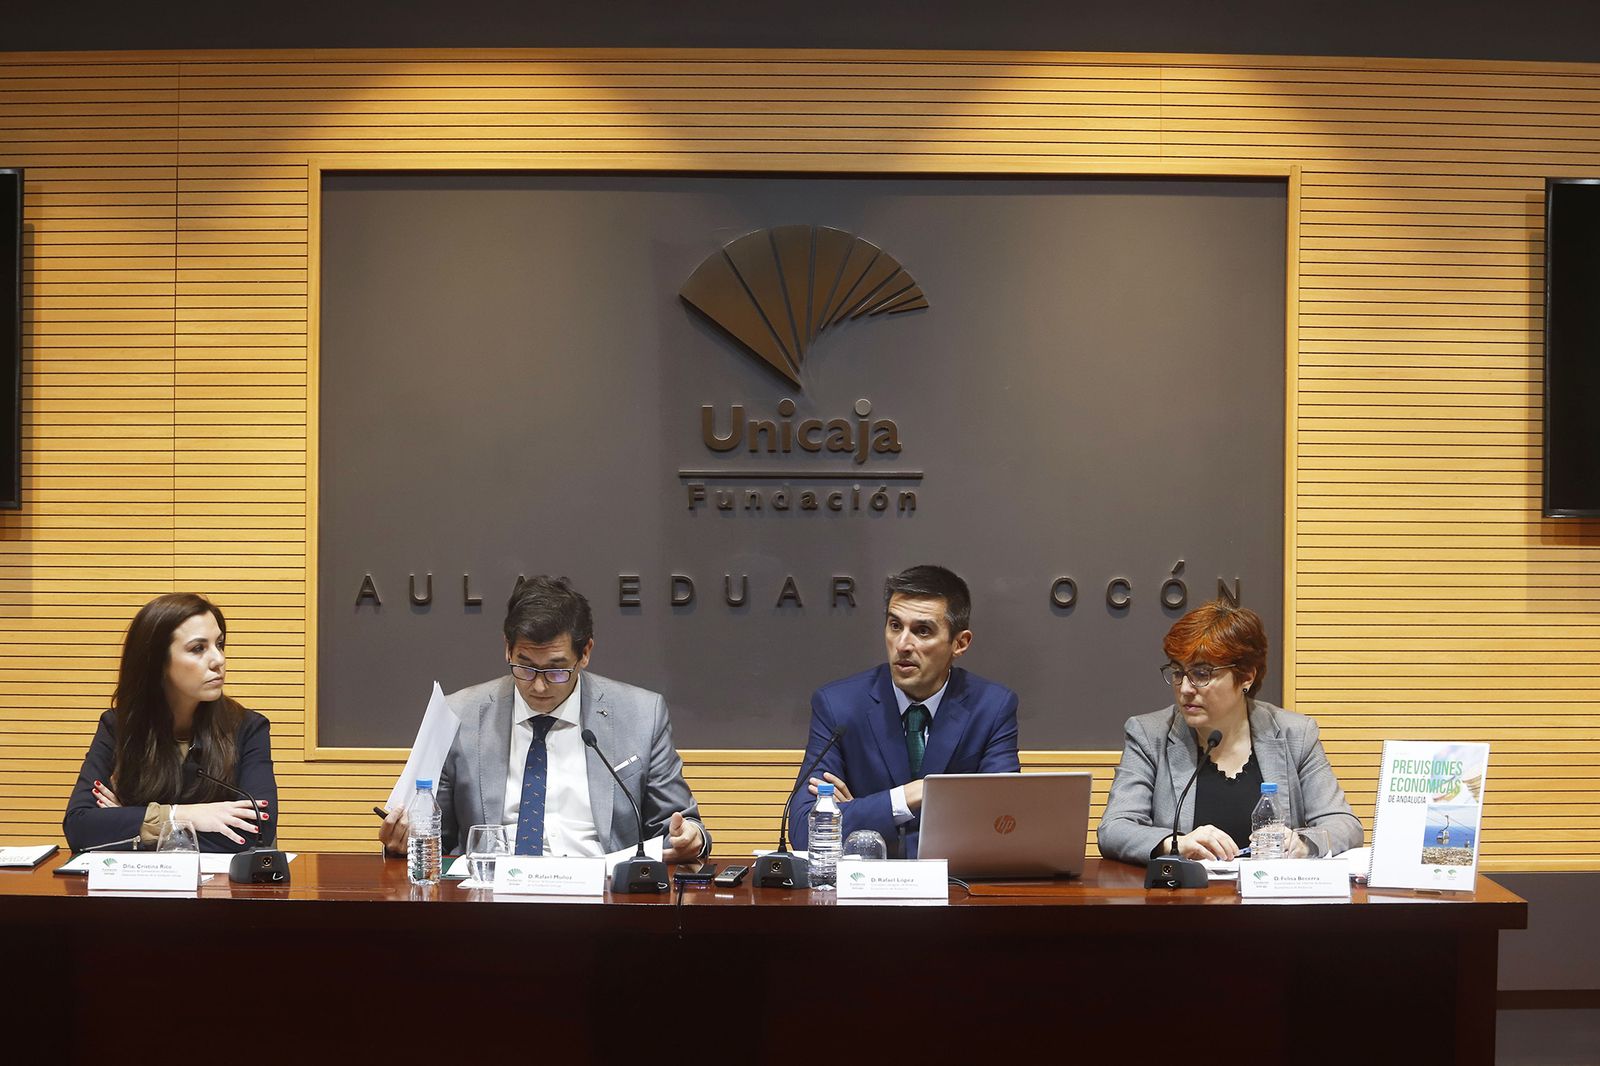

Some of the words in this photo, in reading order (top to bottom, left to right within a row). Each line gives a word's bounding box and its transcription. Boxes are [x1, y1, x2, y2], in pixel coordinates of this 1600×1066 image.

[701, 398, 902, 464] Unicaja
[687, 482, 917, 511] Fundación
[618, 573, 857, 608] EDUAR
[1392, 760, 1463, 776] PREVISIONES
[1389, 775, 1461, 794] ECONÓMICAS
[1387, 794, 1395, 804] DE
